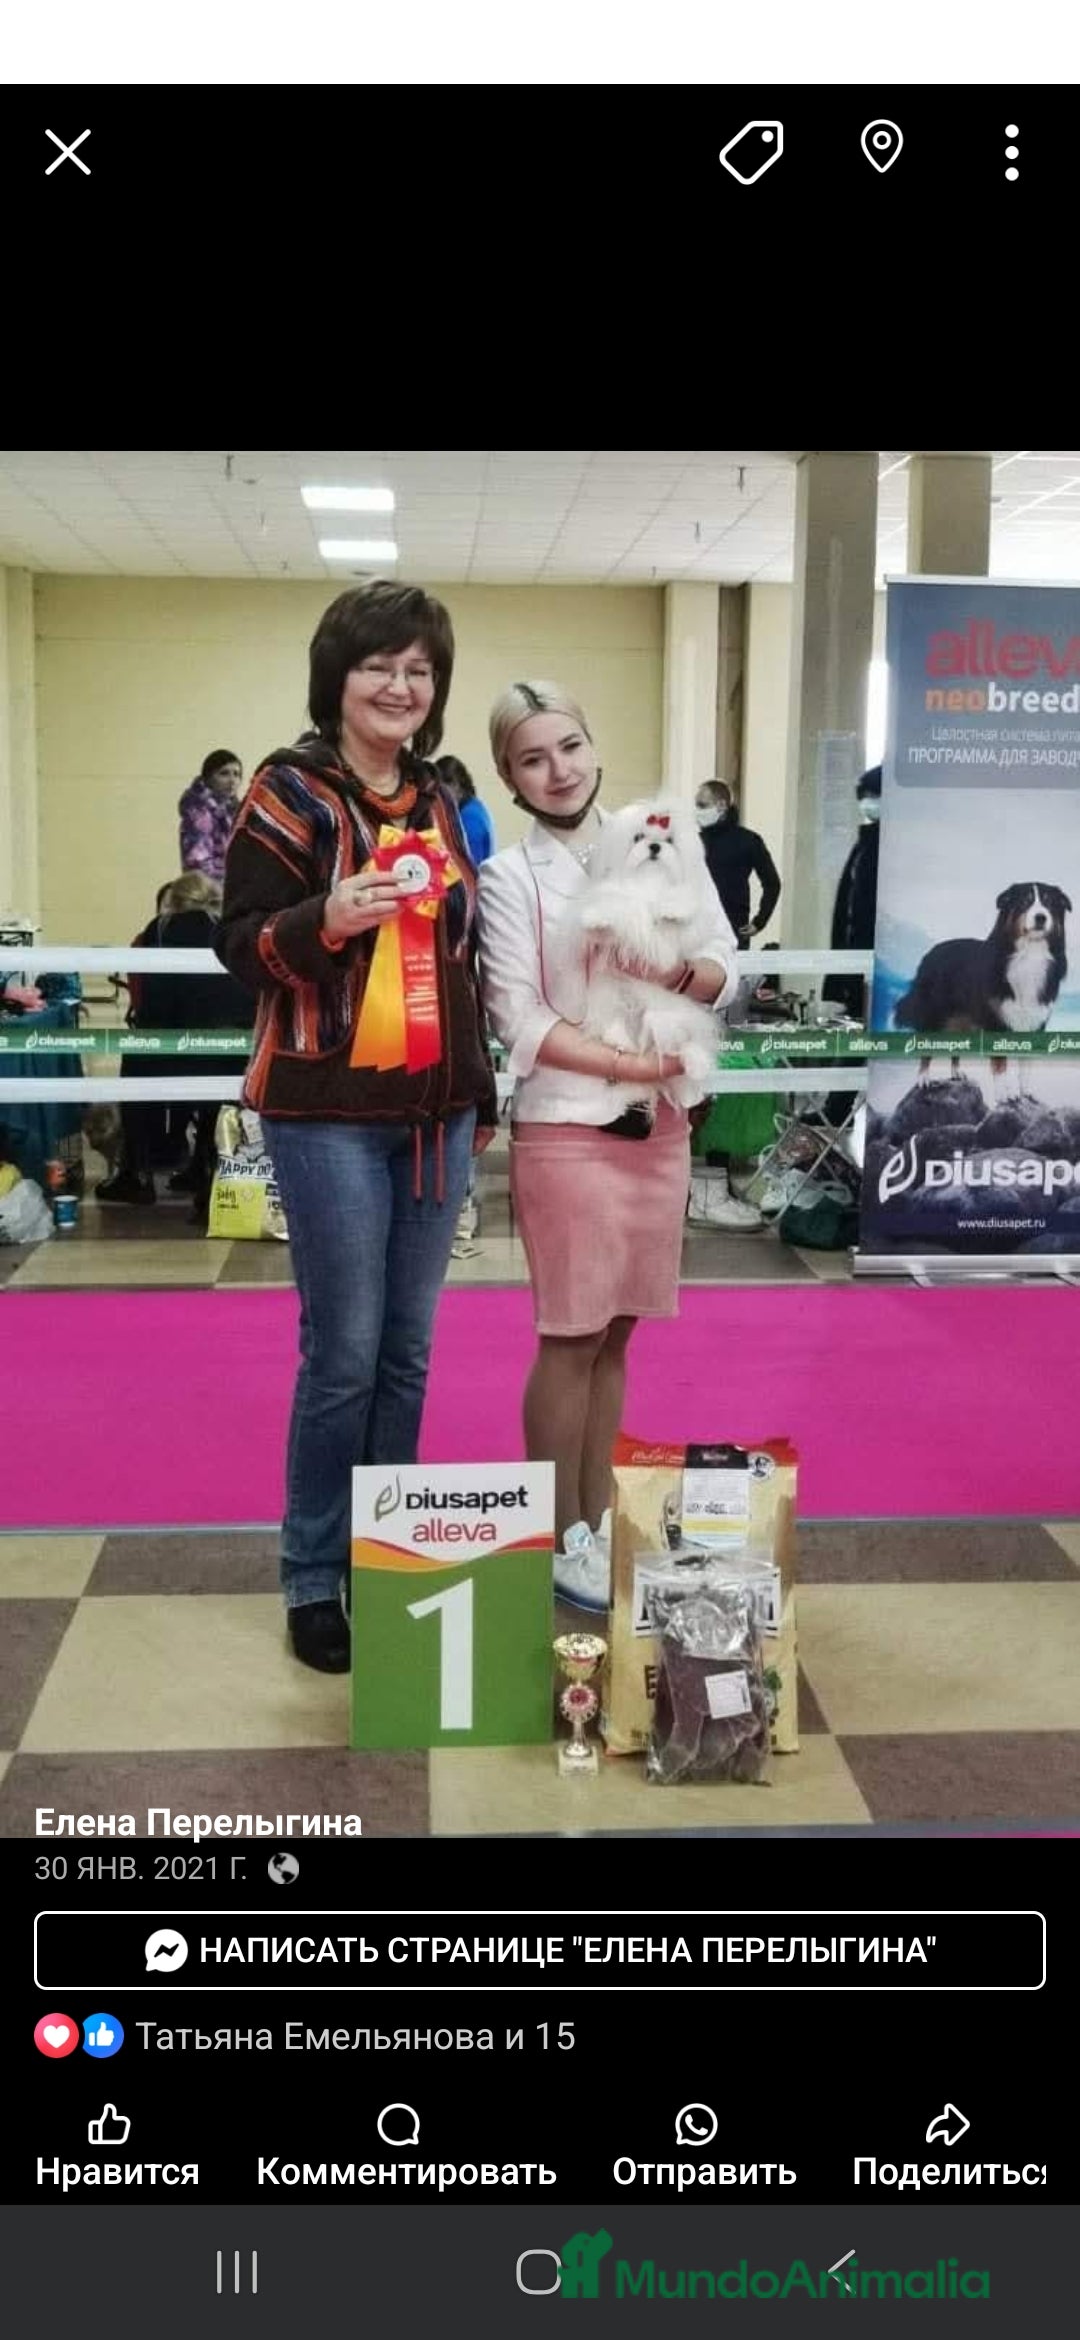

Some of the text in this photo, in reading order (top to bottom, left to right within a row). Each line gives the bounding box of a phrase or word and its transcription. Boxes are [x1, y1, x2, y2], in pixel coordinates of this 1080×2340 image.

[925, 681, 1080, 714] neobreed
[932, 726, 998, 745] Целостная
[908, 746, 997, 764] ПРОГРАММА
[998, 748, 1028, 767] ДЛЯ
[924, 1151, 1080, 1196] Diusap
[957, 1217, 1046, 1229] www.diusapet.ru
[405, 1485, 528, 1514] Diusapet
[412, 1518, 497, 1543] alleva
[406, 1577, 473, 1730] 1
